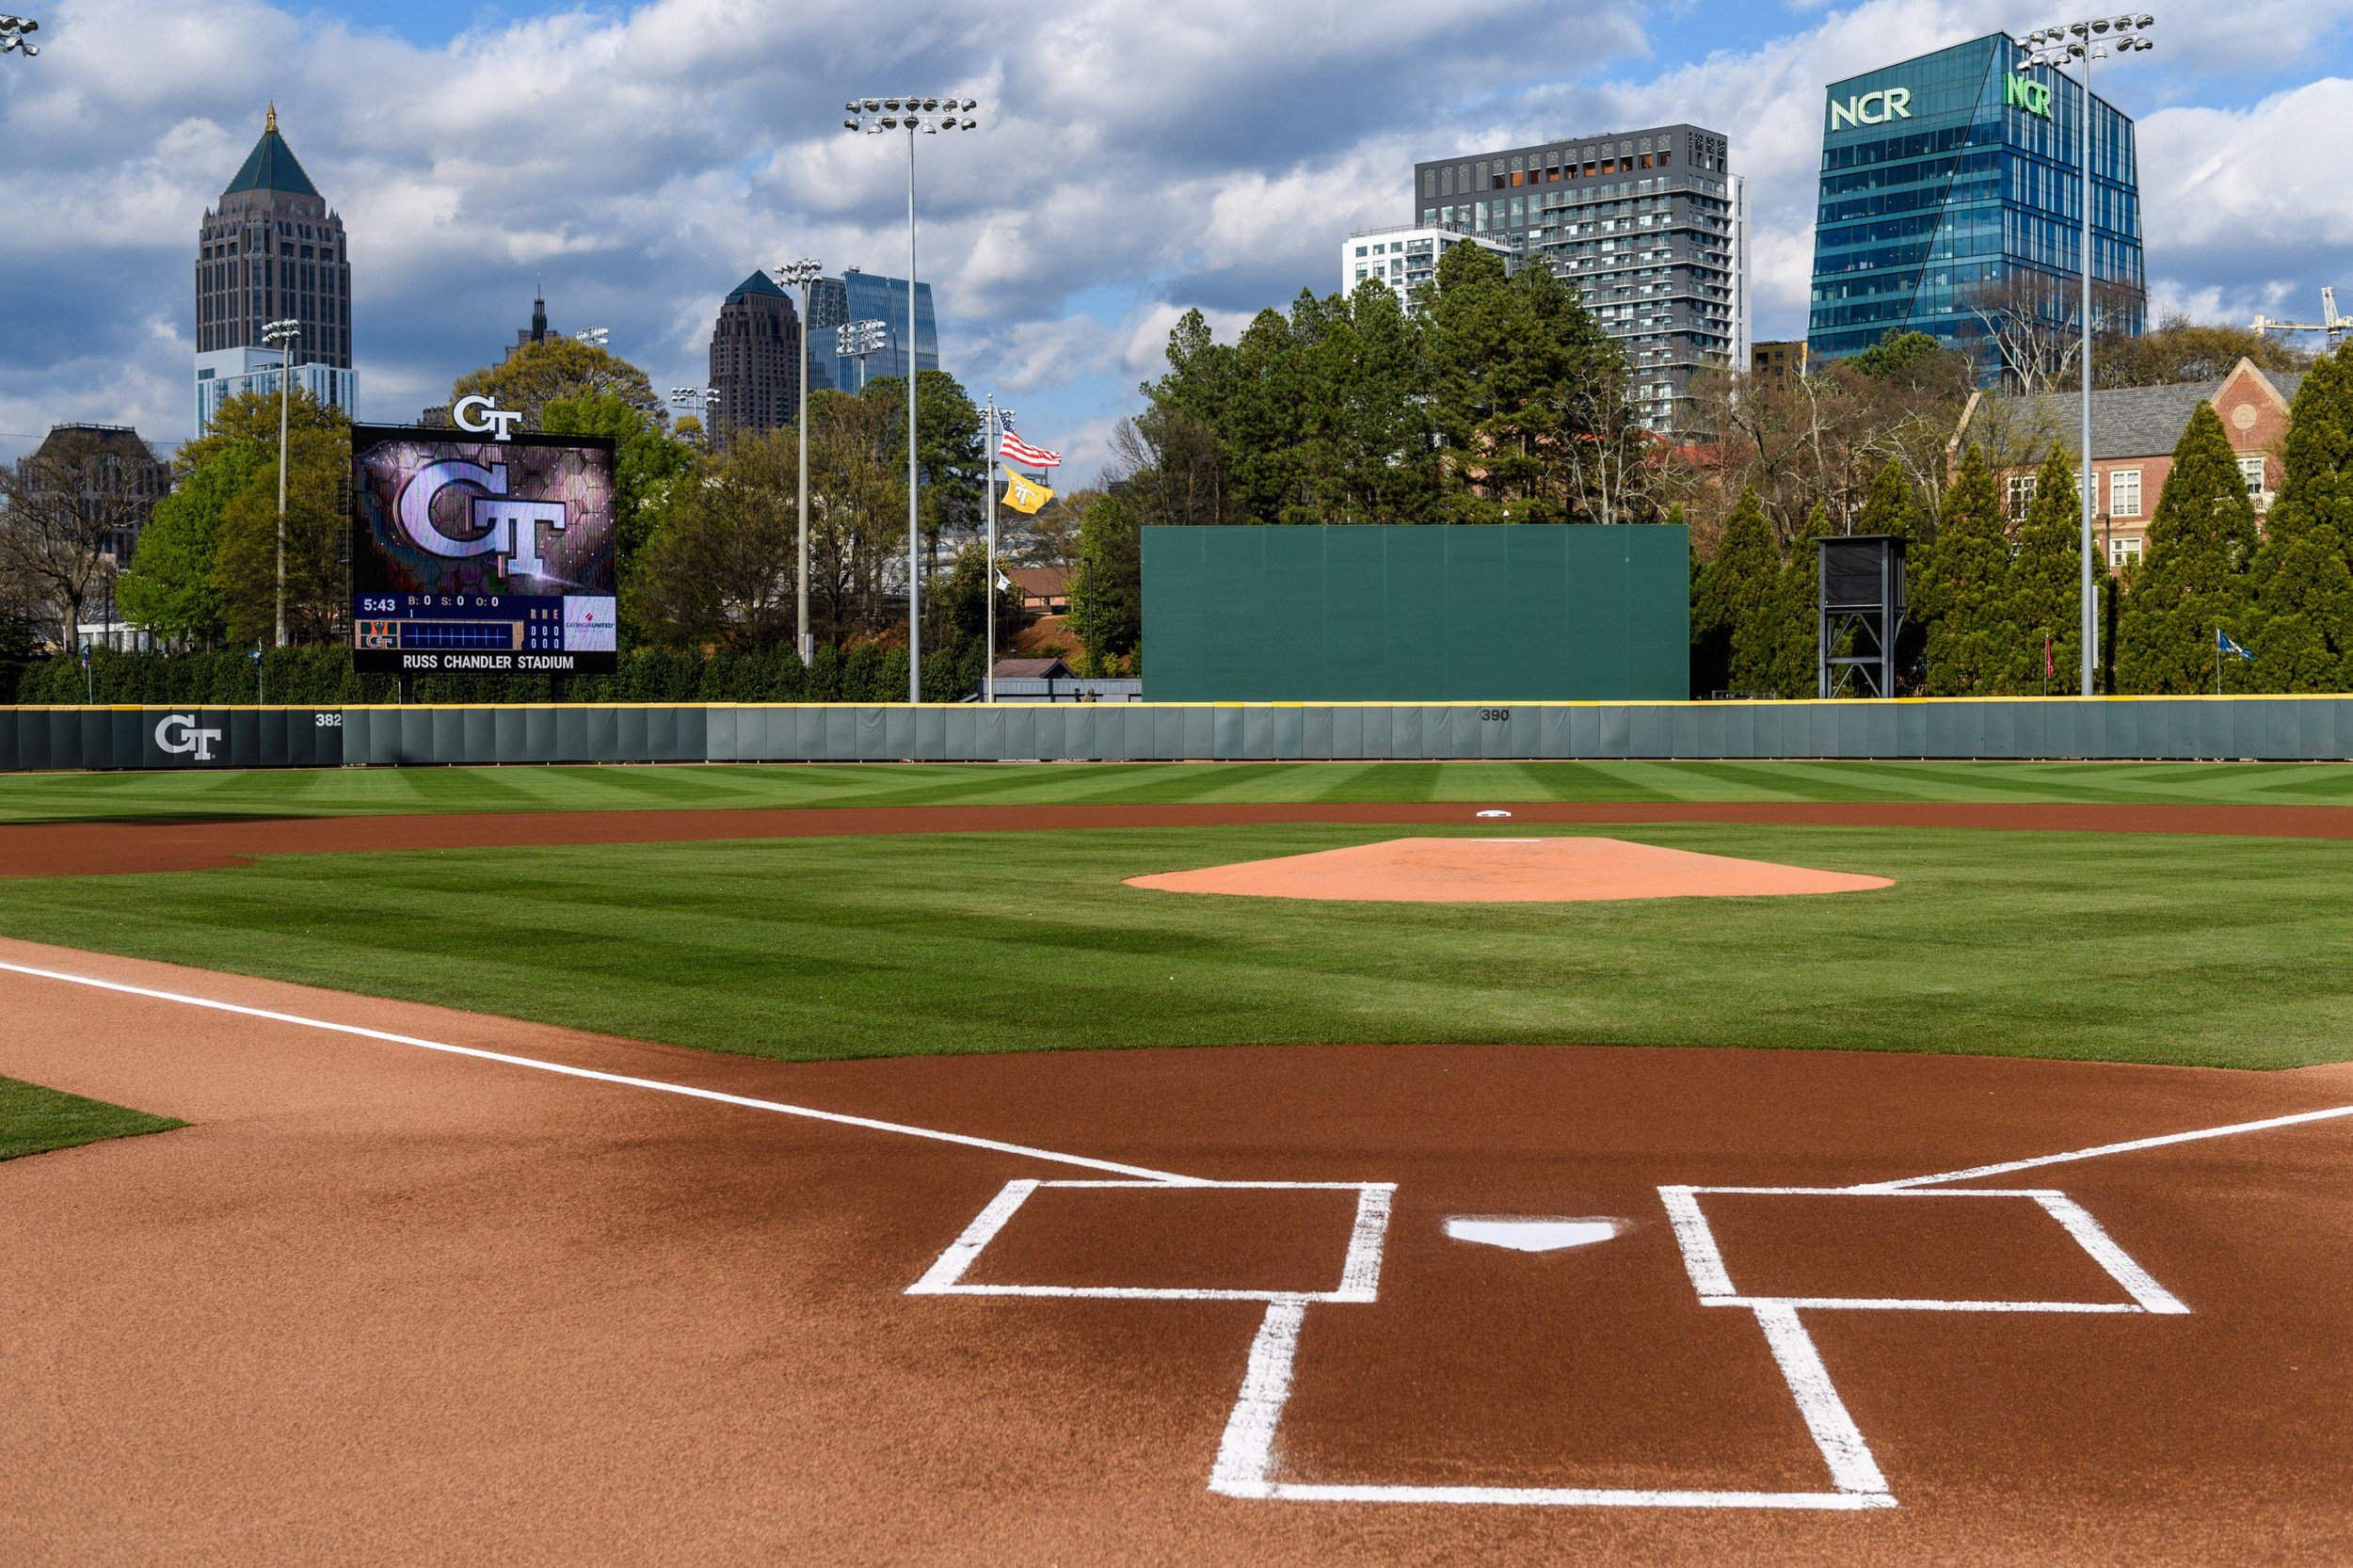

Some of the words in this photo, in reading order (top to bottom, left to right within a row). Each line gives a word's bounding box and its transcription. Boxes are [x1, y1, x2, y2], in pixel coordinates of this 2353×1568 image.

[2007, 72, 2052, 119] NCR
[1832, 88, 1912, 131] NCR
[453, 395, 522, 440] GT
[398, 459, 565, 577] GT
[363, 599, 396, 612] 5:43
[408, 596, 420, 605] B:
[424, 595, 431, 605] 0
[440, 597, 452, 606] S:
[456, 595, 464, 606] 0
[491, 596, 499, 607] 0
[552, 609, 559, 619] E
[531, 625, 536, 636] 0
[542, 625, 548, 636] 0
[553, 626, 559, 636] 0
[531, 638, 536, 648] 0
[542, 638, 548, 648] 0
[553, 638, 559, 649] 0
[403, 655, 438, 668] RUSS
[443, 655, 512, 669] CHANDLER
[518, 656, 574, 669] STADIUM
[315, 713, 342, 727] 382
[1481, 709, 1510, 721] 390
[154, 714, 221, 760] GT
